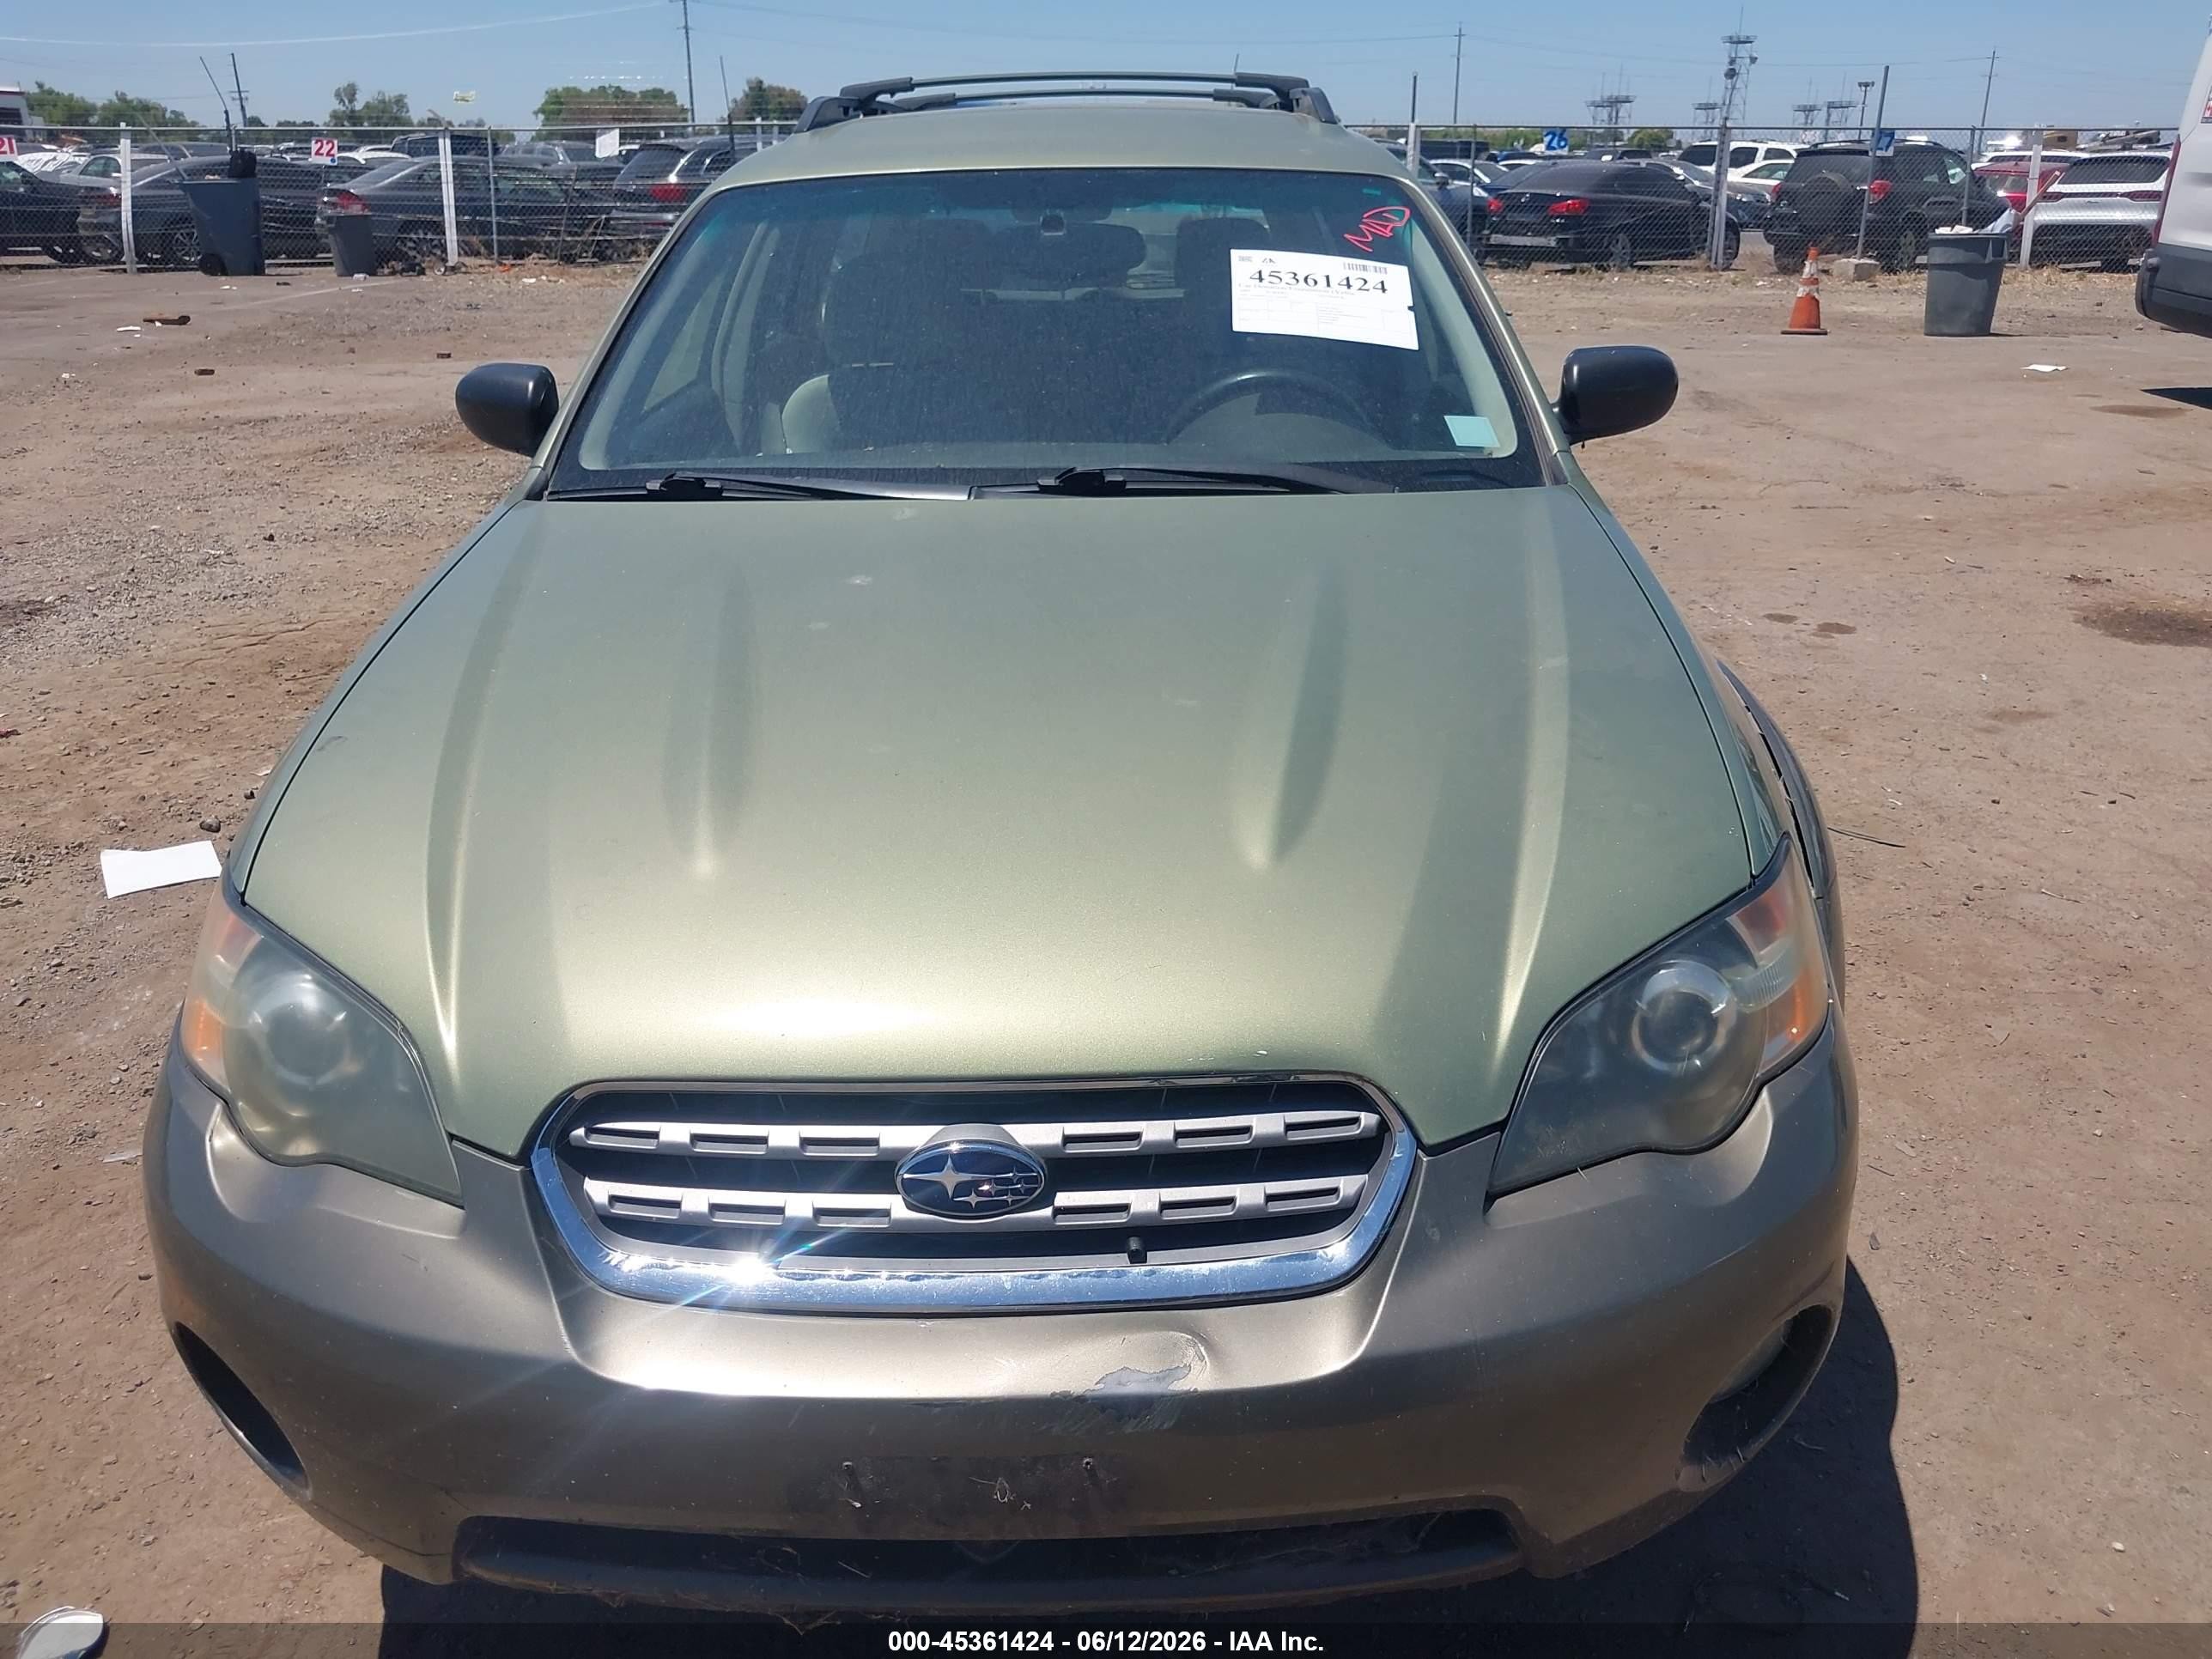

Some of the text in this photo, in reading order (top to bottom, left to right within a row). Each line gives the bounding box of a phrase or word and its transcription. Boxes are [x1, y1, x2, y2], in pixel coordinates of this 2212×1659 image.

[314, 139, 335, 157] 22
[1544, 128, 1568, 151] 26
[1249, 269, 1389, 295] 45361424
